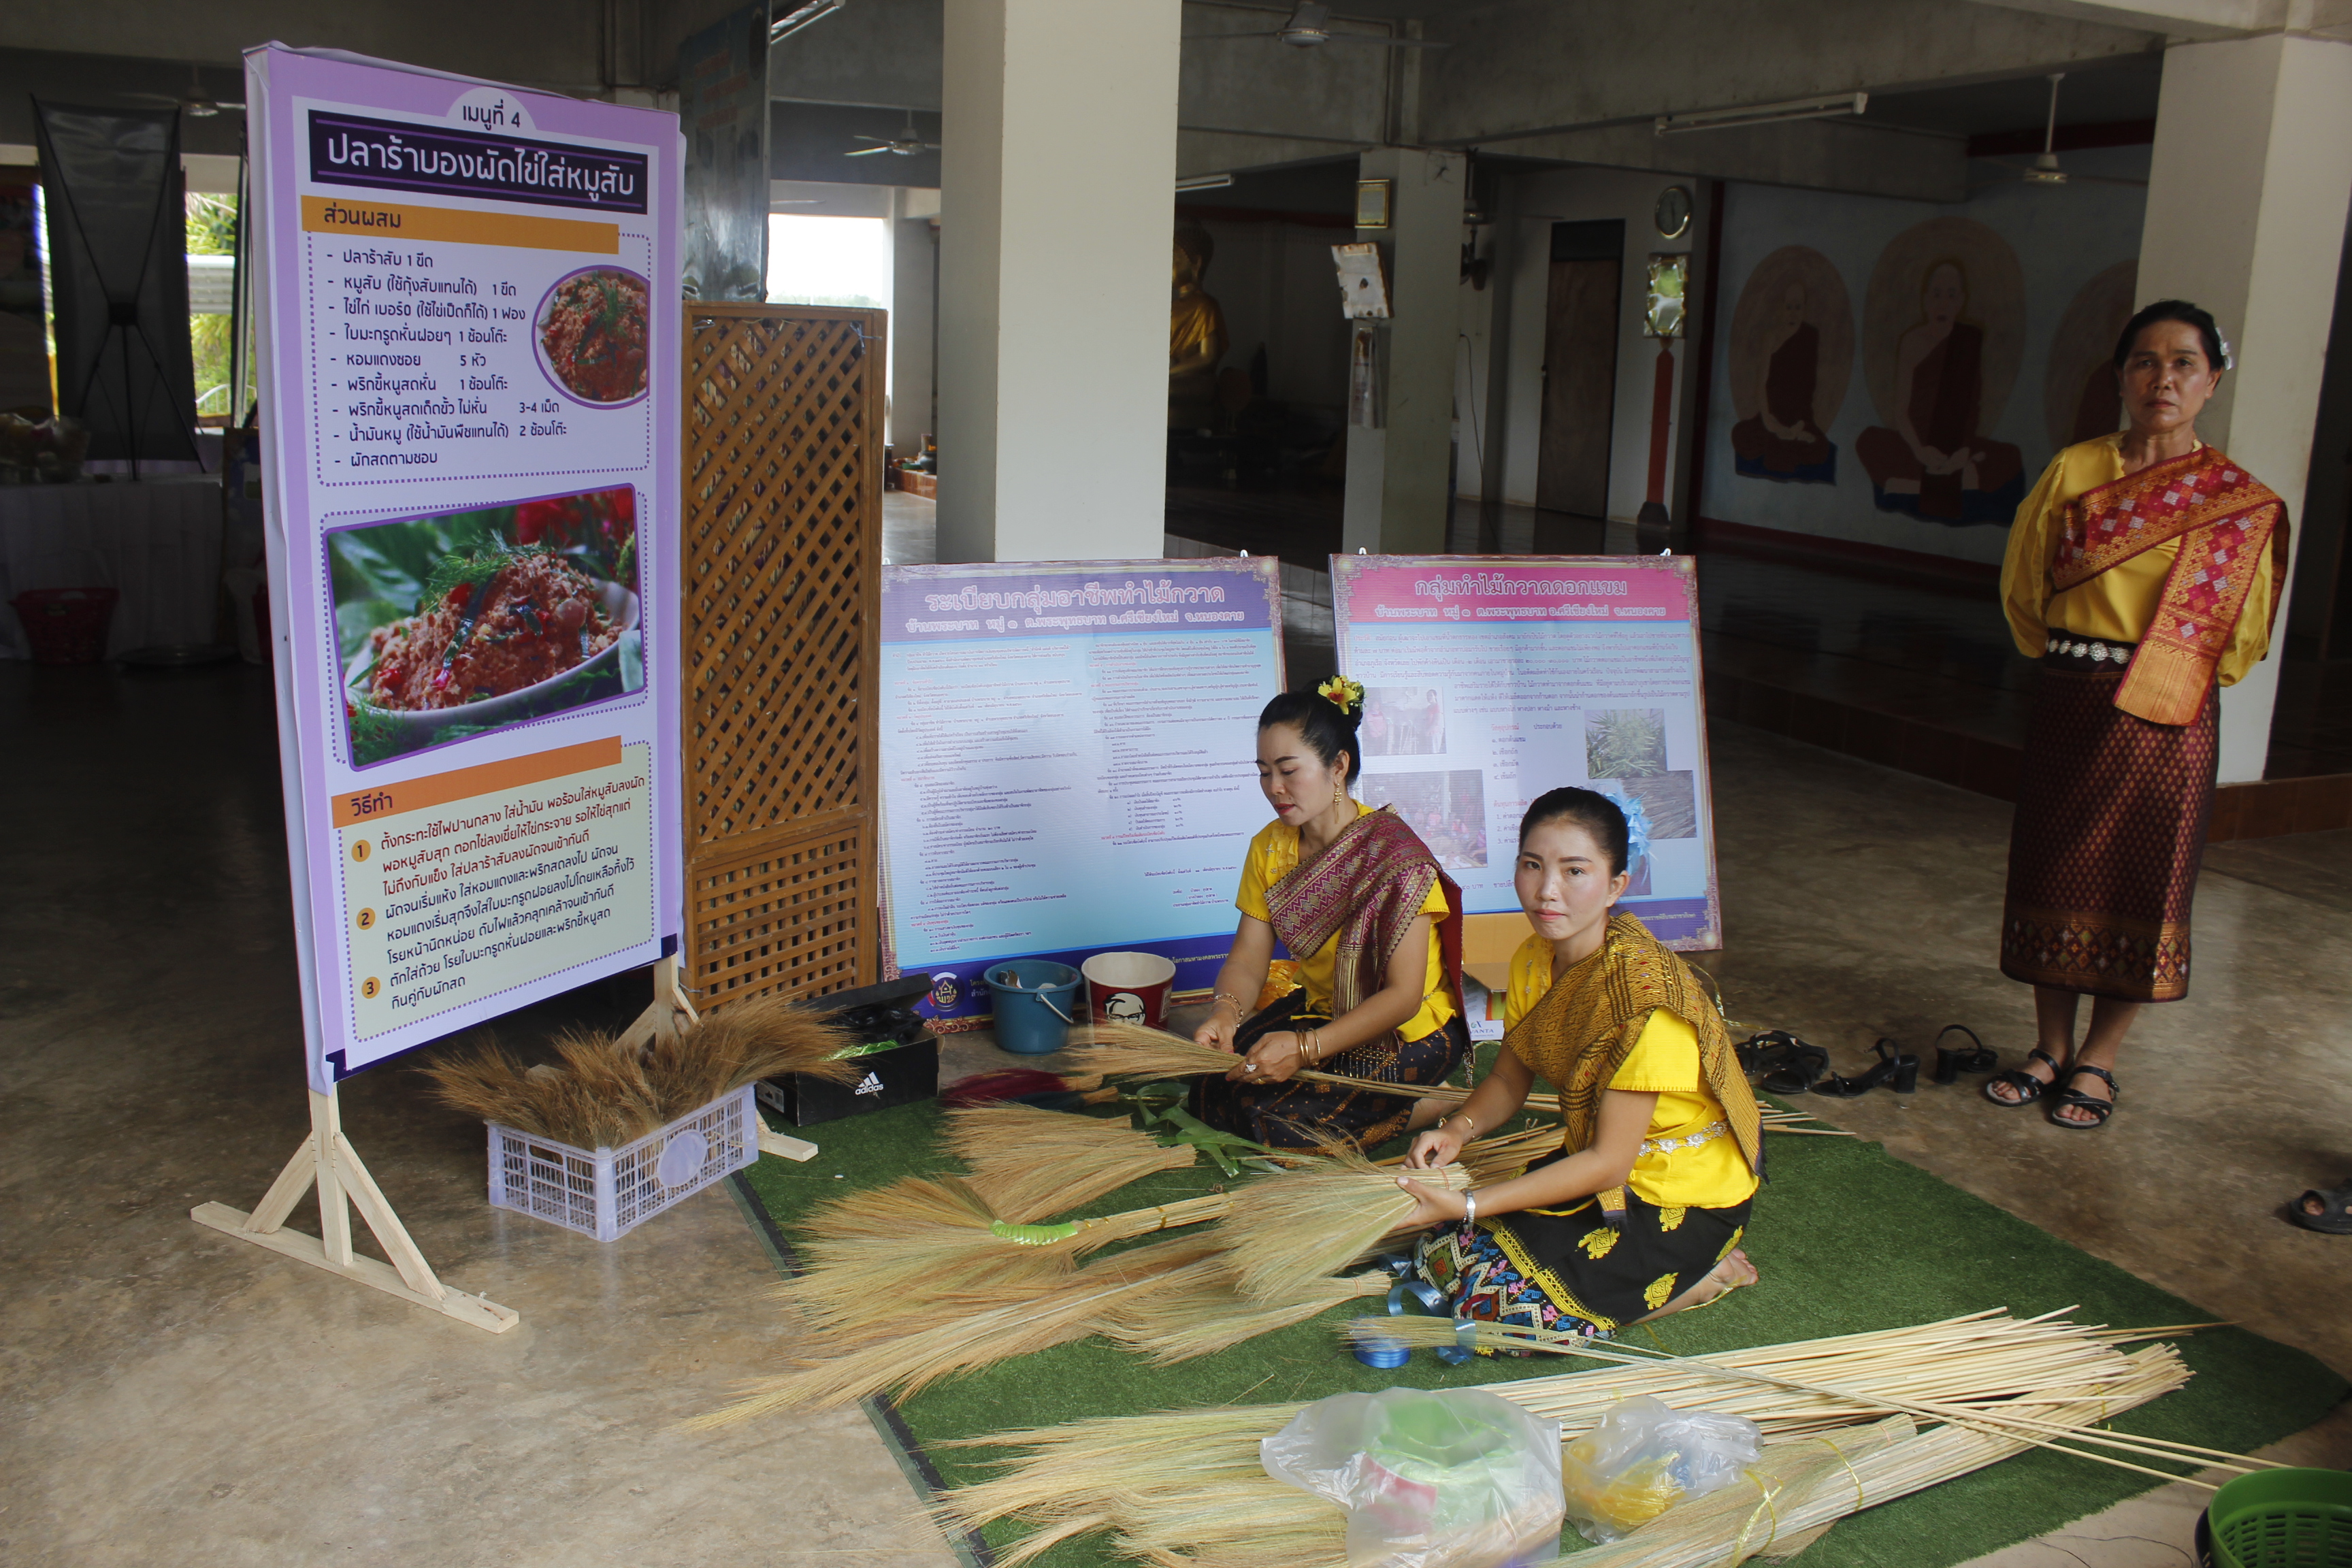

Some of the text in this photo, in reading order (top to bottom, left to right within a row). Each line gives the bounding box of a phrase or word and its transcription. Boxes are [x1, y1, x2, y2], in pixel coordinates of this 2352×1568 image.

[463, 100, 521, 131] เมนูที่ 4
[328, 133, 634, 202] ปลาร้าบองผัดไข่ใส่หมูสับ
[324, 202, 402, 228] ส่วนผสม
[344, 248, 434, 268] ปลาร้าสับ 1 ขีด
[344, 274, 517, 297] หมูสับ (ใช้กุ้งสับแทนได้) 1 ขีด
[344, 297, 370, 315] ไข่ไก่
[416, 299, 488, 321] (ใช้ไข่เป็ดก็ได้)
[492, 308, 497, 319] 1
[502, 307, 526, 320] ฟอง
[344, 322, 508, 346] ใบมะกรูดหั่นฝอยๆ 1 ช้อนโต๊ะ
[347, 350, 487, 367] หอมแดงซอย 5 หัว
[347, 372, 508, 396] พริกขี้หนูสดหั่น 1 ช้อนโต๊ะ
[348, 396, 559, 421] พริกขี้หนูสดเด็ดขั้ว ไม่หั่น 3-4 เม็ด
[349, 420, 567, 445] น้ำมันหมู (ใช้น้ำมันพืชแทนได้) 2 ช้อนโต๊ะ
[350, 451, 438, 467] ผักสดตามชอบ
[925, 580, 1225, 615] ระเบียบกลุ่มอาชีพทำไม้กวาด
[1415, 573, 1627, 602] กลุ่มทำไม้กวาดดอกแขม
[905, 618, 979, 632] บ้านพระบาท
[986, 616, 1004, 633] หมู่
[1025, 615, 1107, 630] ต.พระพุทธบาท
[1109, 610, 1179, 624] อ.ศรีเชียงใหม่
[1185, 610, 1245, 623] จ.หนองคาย
[1375, 604, 1437, 617] บ้านพระบาท
[1443, 604, 1460, 620] หมู่
[1476, 607, 1547, 619] ต.พระพุทธบาท
[1549, 604, 1609, 617] อ.ศรีเชียงใหม่
[1614, 606, 1665, 617] จ.หนองคาย
[350, 791, 393, 817] วิธีทำ
[357, 776, 644, 858] 1 ตั้งกระทะใช้ไฟปานกลาง ใส่น้ำมัน พอร้อนใส่หมูสับลงผัด
[383, 847, 449, 872] พอหมูสับสุก
[576, 802, 630, 823] รอให้ไข่สุกแต่
[382, 829, 589, 896] ไม่ถึงกับแข็ง ใส่ปลาร้าสับลงผัดจนเข้ากันดี
[361, 845, 620, 926] 2 ผัดจนเริ่มแห้ง ใส่หอมแดงและพริกสดลงไป ผัดจน
[387, 883, 614, 964] โรยหน้านิดหน่อย ดับไฟแล้วคลุกเคล้าจนเข้ากันดี
[365, 981, 374, 995] 3
[391, 962, 440, 986] ตักใส่ถ้วย
[392, 977, 465, 1009] กินคู่กับผักสด
[855, 1083, 884, 1096] adidas
